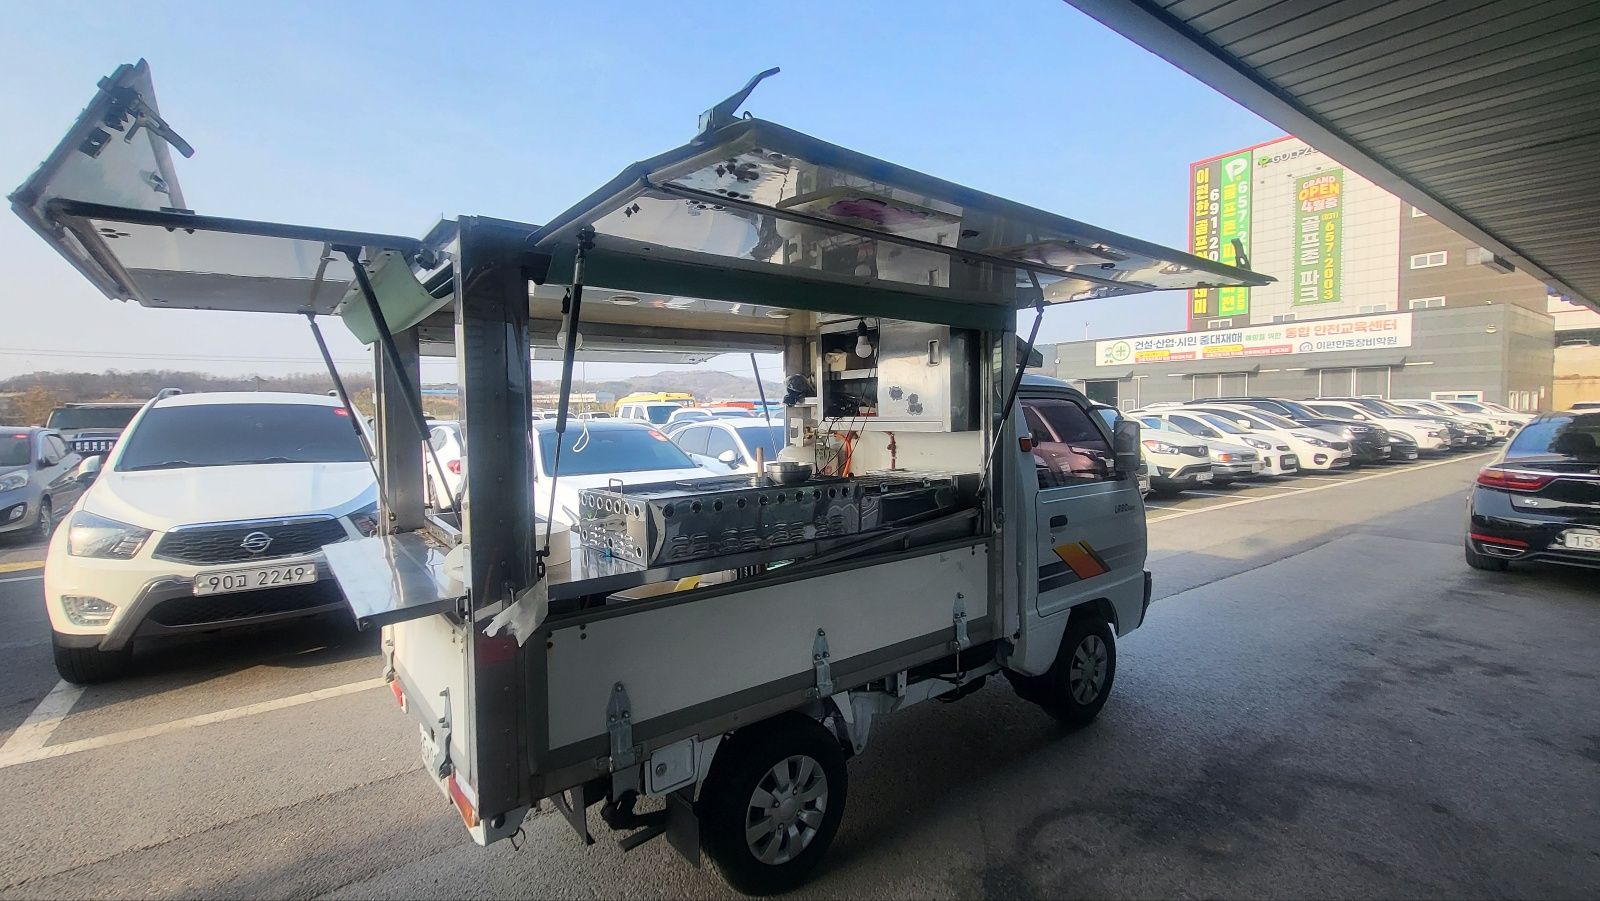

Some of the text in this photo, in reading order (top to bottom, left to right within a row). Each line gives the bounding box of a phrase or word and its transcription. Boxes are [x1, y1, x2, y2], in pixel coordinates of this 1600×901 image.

[1298, 183, 1340, 201] OPEN
[1302, 176, 1336, 189] GRAND
[1300, 215, 1320, 303] 골프존 파크
[1285, 326, 1310, 338] 통합
[1314, 319, 1397, 336] 안전교육센터
[208, 567, 305, 592] 90고 2249
